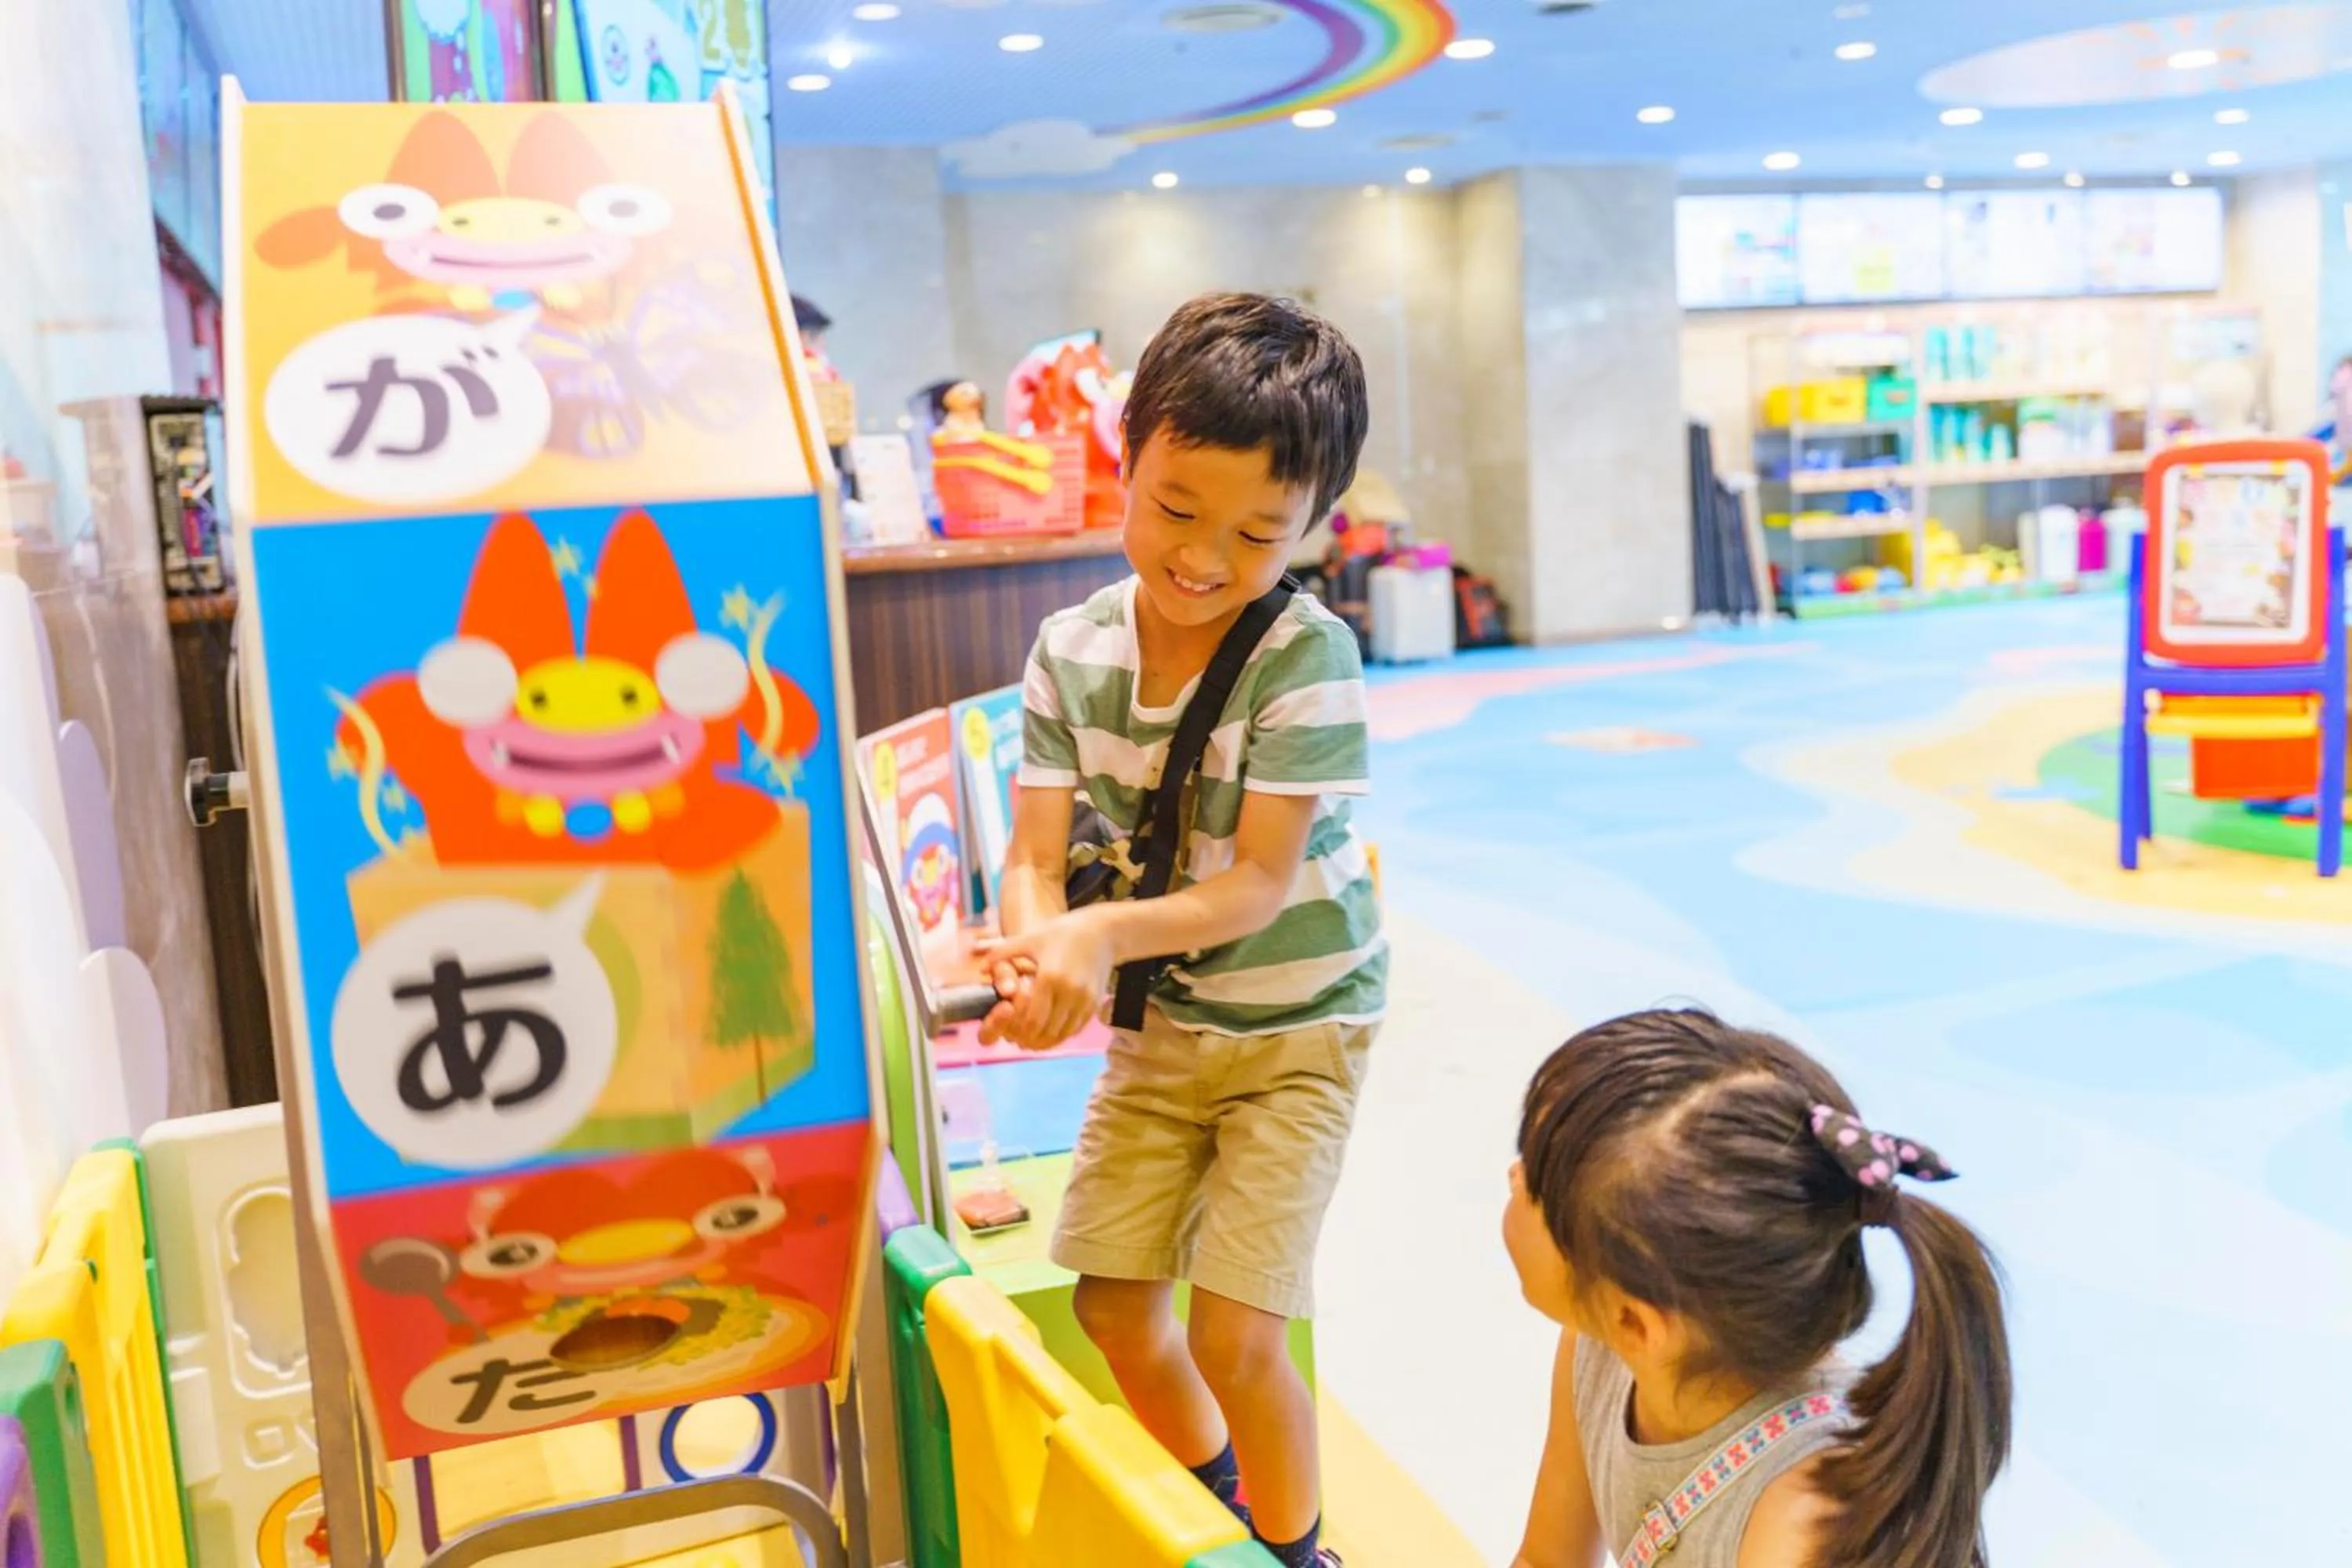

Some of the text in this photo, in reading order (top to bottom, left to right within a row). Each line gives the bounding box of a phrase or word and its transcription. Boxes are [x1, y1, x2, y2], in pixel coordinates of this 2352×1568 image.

[325, 346, 499, 459] が
[391, 956, 568, 1112] あ
[449, 1357, 597, 1424] た
